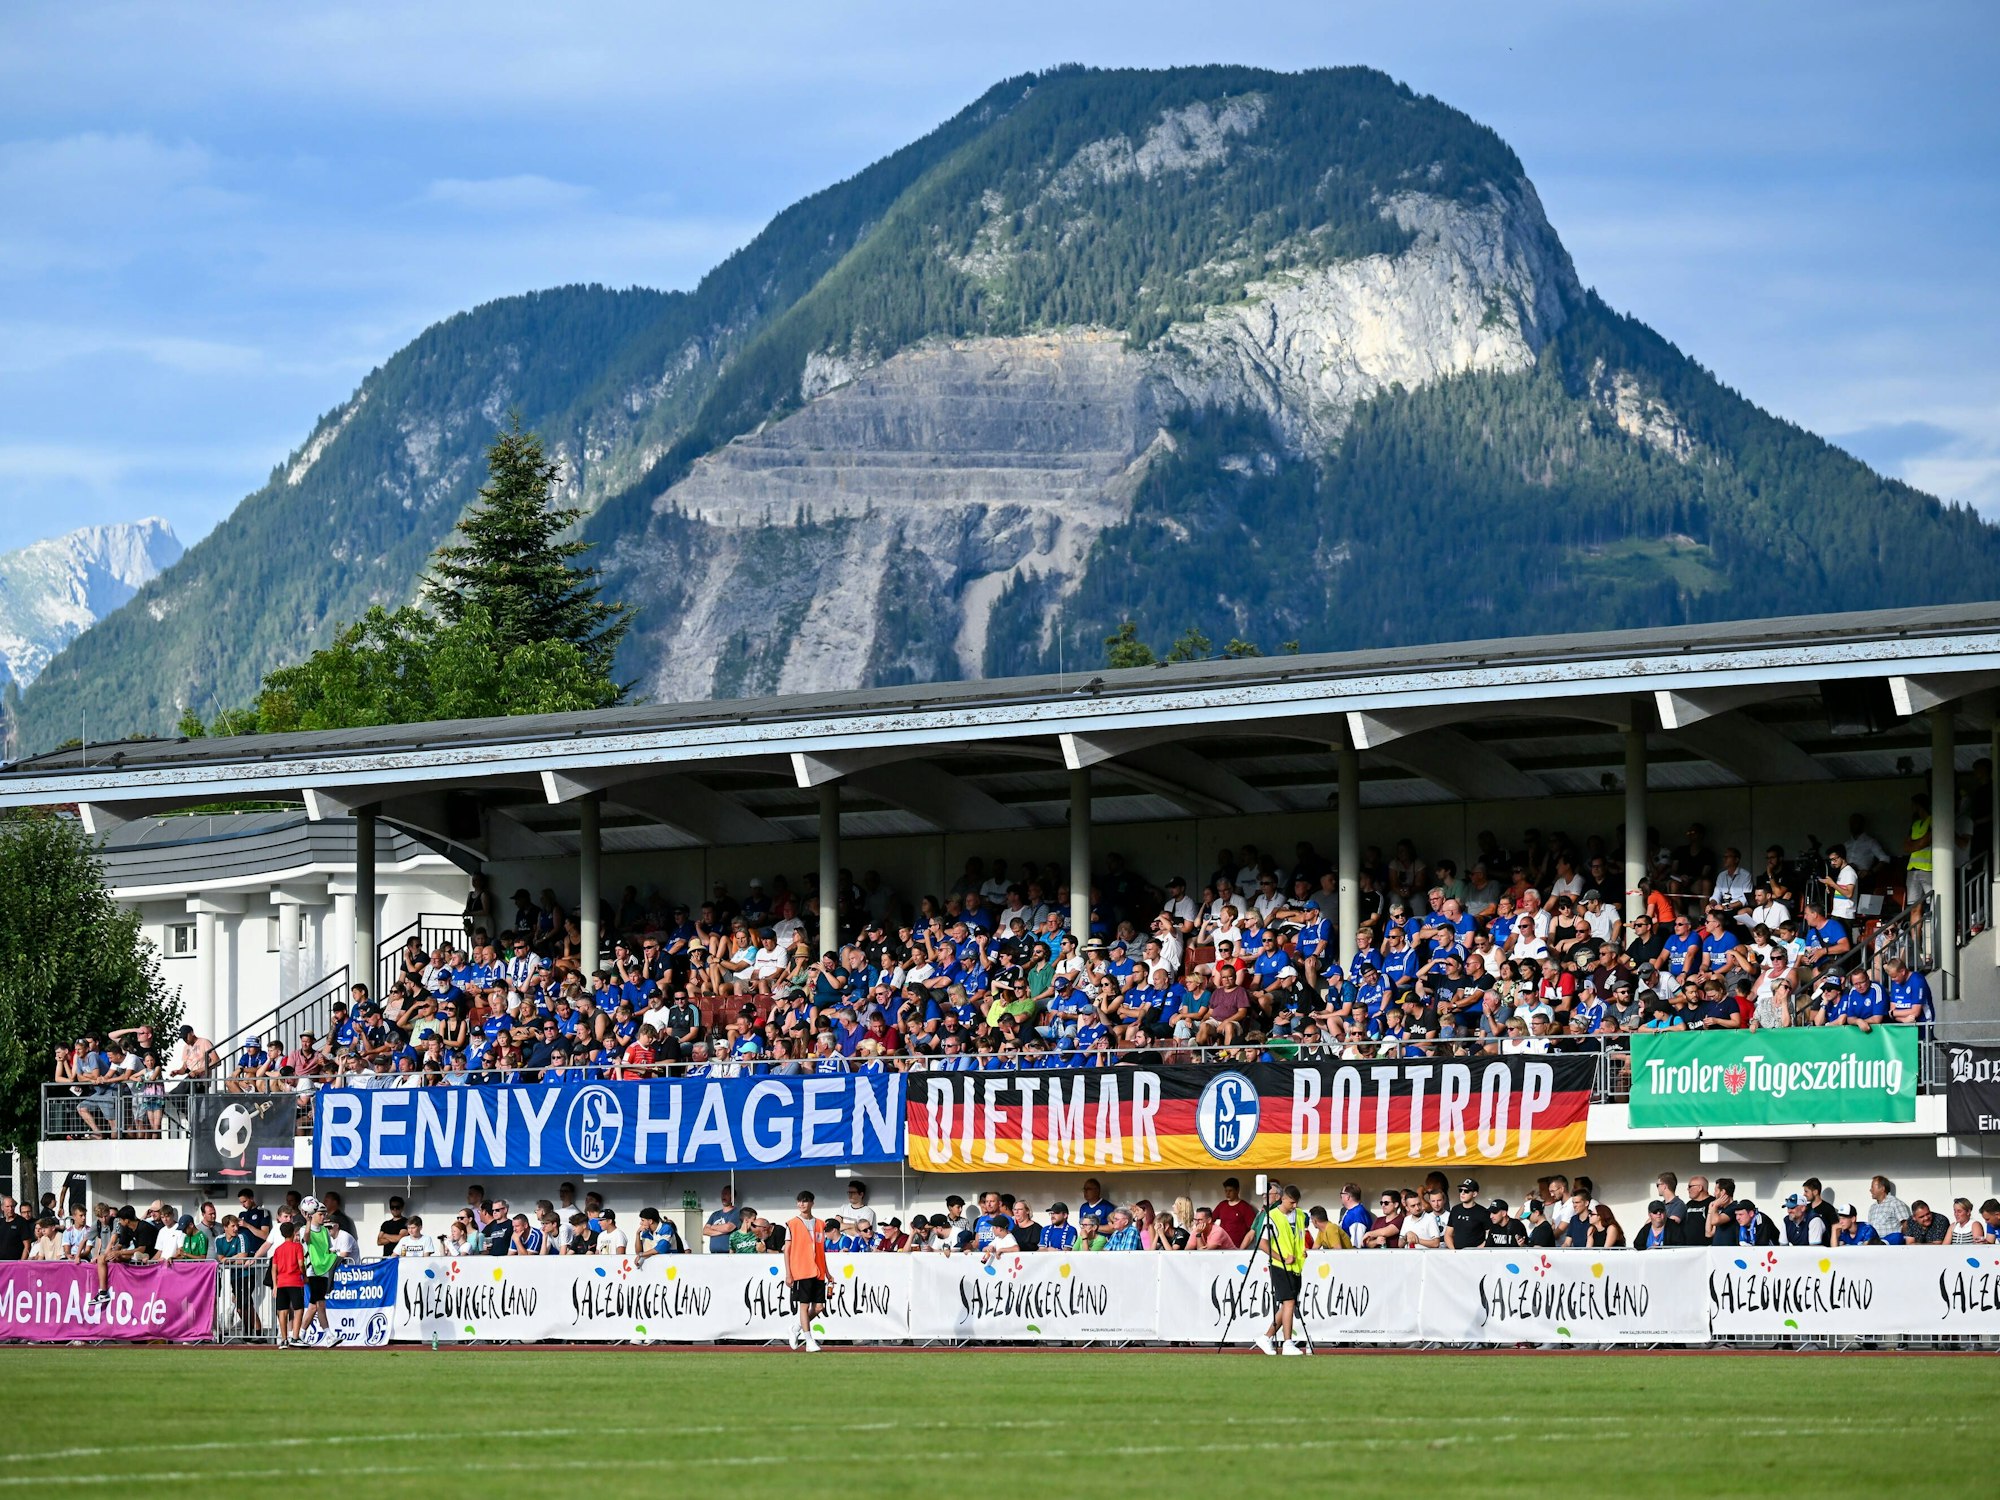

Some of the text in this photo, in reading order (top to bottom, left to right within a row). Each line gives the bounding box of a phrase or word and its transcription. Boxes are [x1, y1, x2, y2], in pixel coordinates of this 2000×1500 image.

[1645, 1053, 1903, 1098] Tiroler Tageszeitung
[320, 1073, 900, 1170] BENNY HAGEN
[926, 1062, 1554, 1165] DIETMAR BOTTROP
[333, 1268, 374, 1285] nigsblau
[359, 1285, 384, 1300] 2000
[341, 1317, 355, 1328] on
